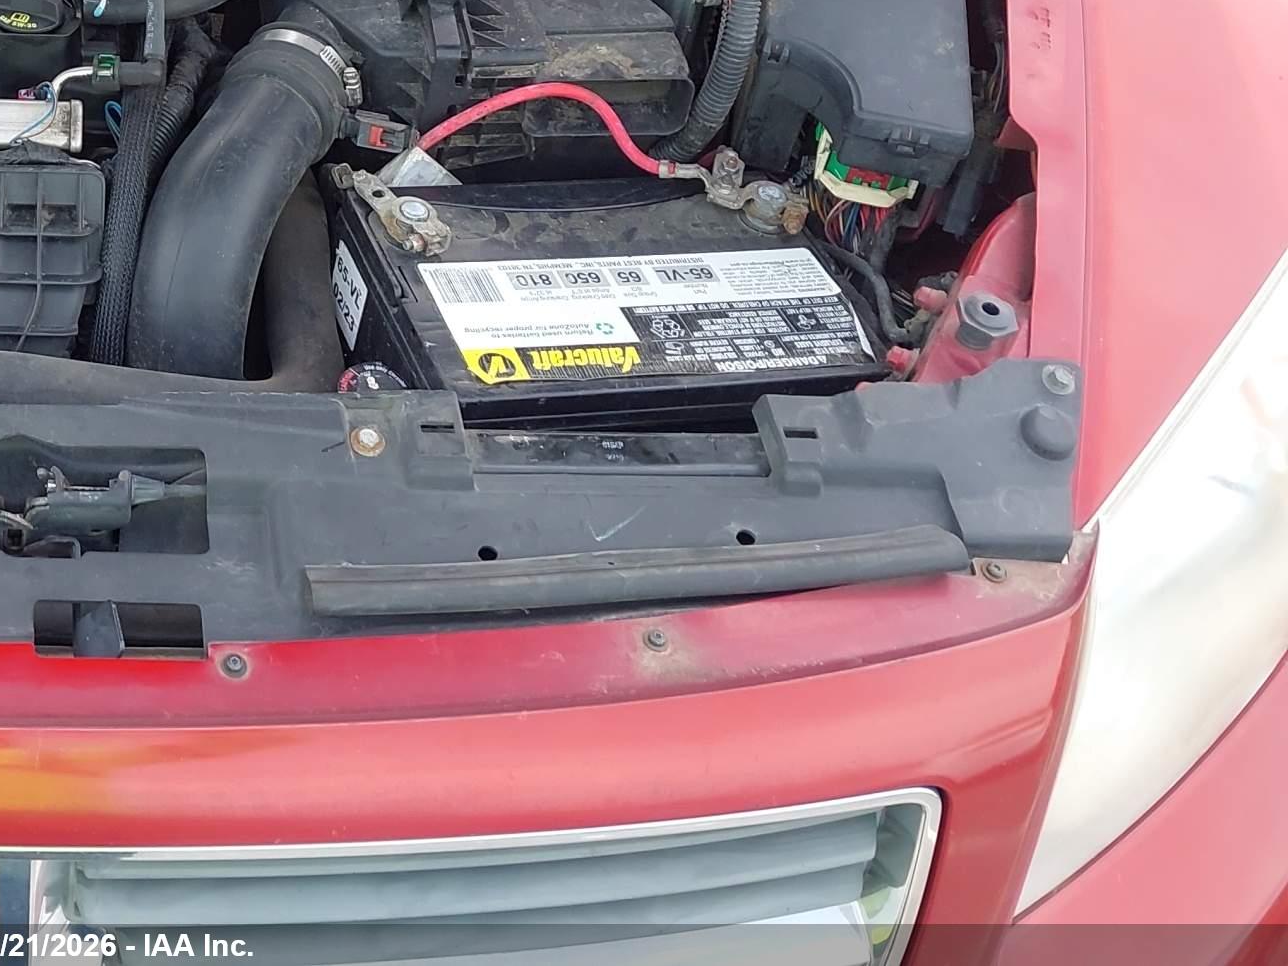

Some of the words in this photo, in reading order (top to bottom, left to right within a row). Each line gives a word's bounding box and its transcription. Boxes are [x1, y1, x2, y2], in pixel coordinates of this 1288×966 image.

[656, 258, 704, 266] DISTRIBUTED
[515, 274, 552, 286] 810
[565, 272, 601, 284] 650
[617, 271, 641, 282] 65
[656, 267, 713, 281] 65-VL
[338, 256, 360, 310] 65-VL
[334, 282, 355, 332] 02/23
[530, 345, 640, 373] Valucraft
[714, 356, 817, 371] DANGER/POISON
